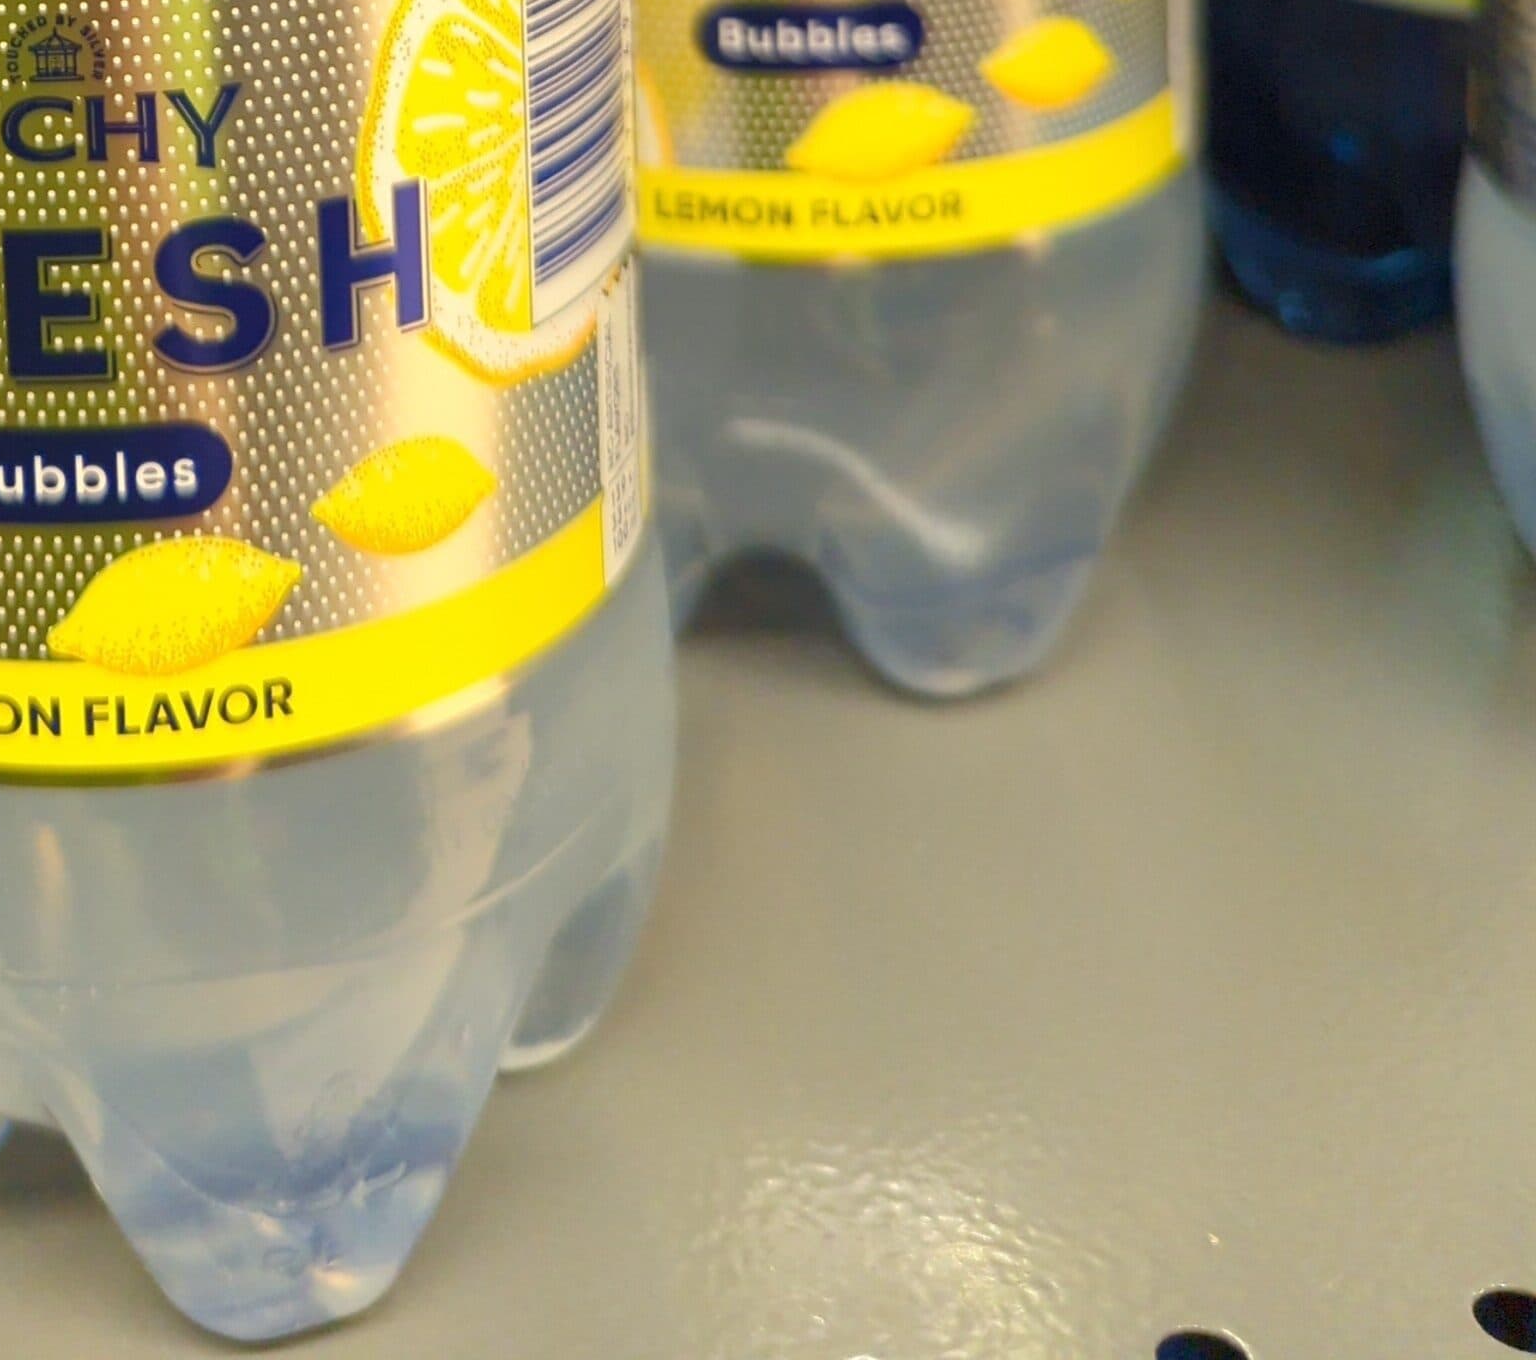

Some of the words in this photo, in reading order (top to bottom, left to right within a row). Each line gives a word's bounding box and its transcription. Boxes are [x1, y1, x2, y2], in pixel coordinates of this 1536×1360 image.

[7, 15, 47, 84] TOUCHED
[56, 13, 77, 28] BY
[80, 25, 106, 80] SILVER
[716, 16, 910, 62] Bubbles
[653, 189, 793, 228] LEMON
[810, 190, 964, 228] FLAVOR
[83, 677, 294, 737] FLAVOR
